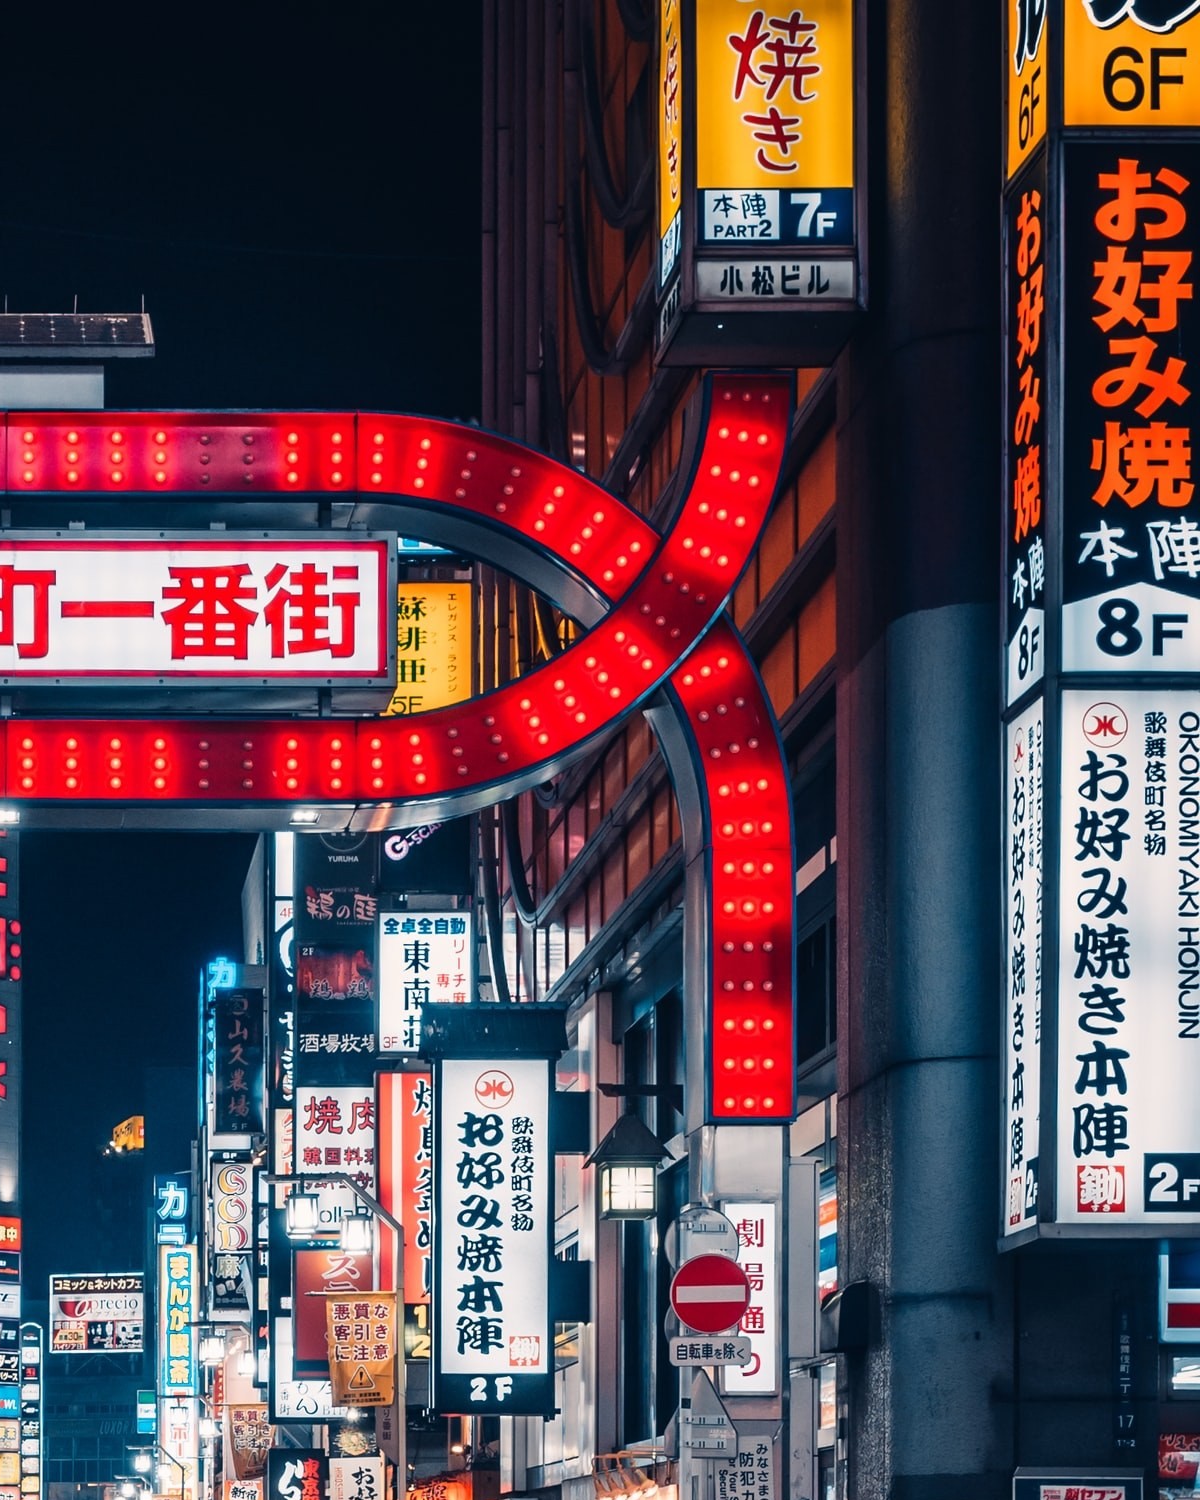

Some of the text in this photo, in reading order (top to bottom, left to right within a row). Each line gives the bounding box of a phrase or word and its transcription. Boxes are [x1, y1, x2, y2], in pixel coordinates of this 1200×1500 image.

[1103, 46, 1188, 112] 6F
[712, 193, 767, 219] 本陣
[790, 192, 838, 238] 7F
[713, 220, 772, 238] PART2
[719, 264, 830, 296] 小松ビル
[1091, 158, 1196, 509] お好み焼
[1096, 597, 1190, 658] 8F
[1143, 711, 1168, 857] 歌舞伎町名物
[383, 917, 466, 935] 全卓全自動
[1072, 750, 1132, 1160] お好み焼き本陣
[382, 1036, 399, 1049] 3F
[510, 1116, 534, 1232] 歌舞伎町名物
[1148, 1161, 1200, 1203] 2F
[456, 1112, 505, 1355] お好み焼本陣
[54, 1279, 143, 1291] コミック&ネットカフェ
[333, 1303, 389, 1321] 悪質な
[333, 1323, 389, 1341] 客引き
[333, 1344, 389, 1362] に注意
[676, 1343, 746, 1361] 自転車を除く
[469, 1376, 514, 1402] 2F
[1117, 1414, 1135, 1429] 17
[729, 1470, 739, 1490] Your
